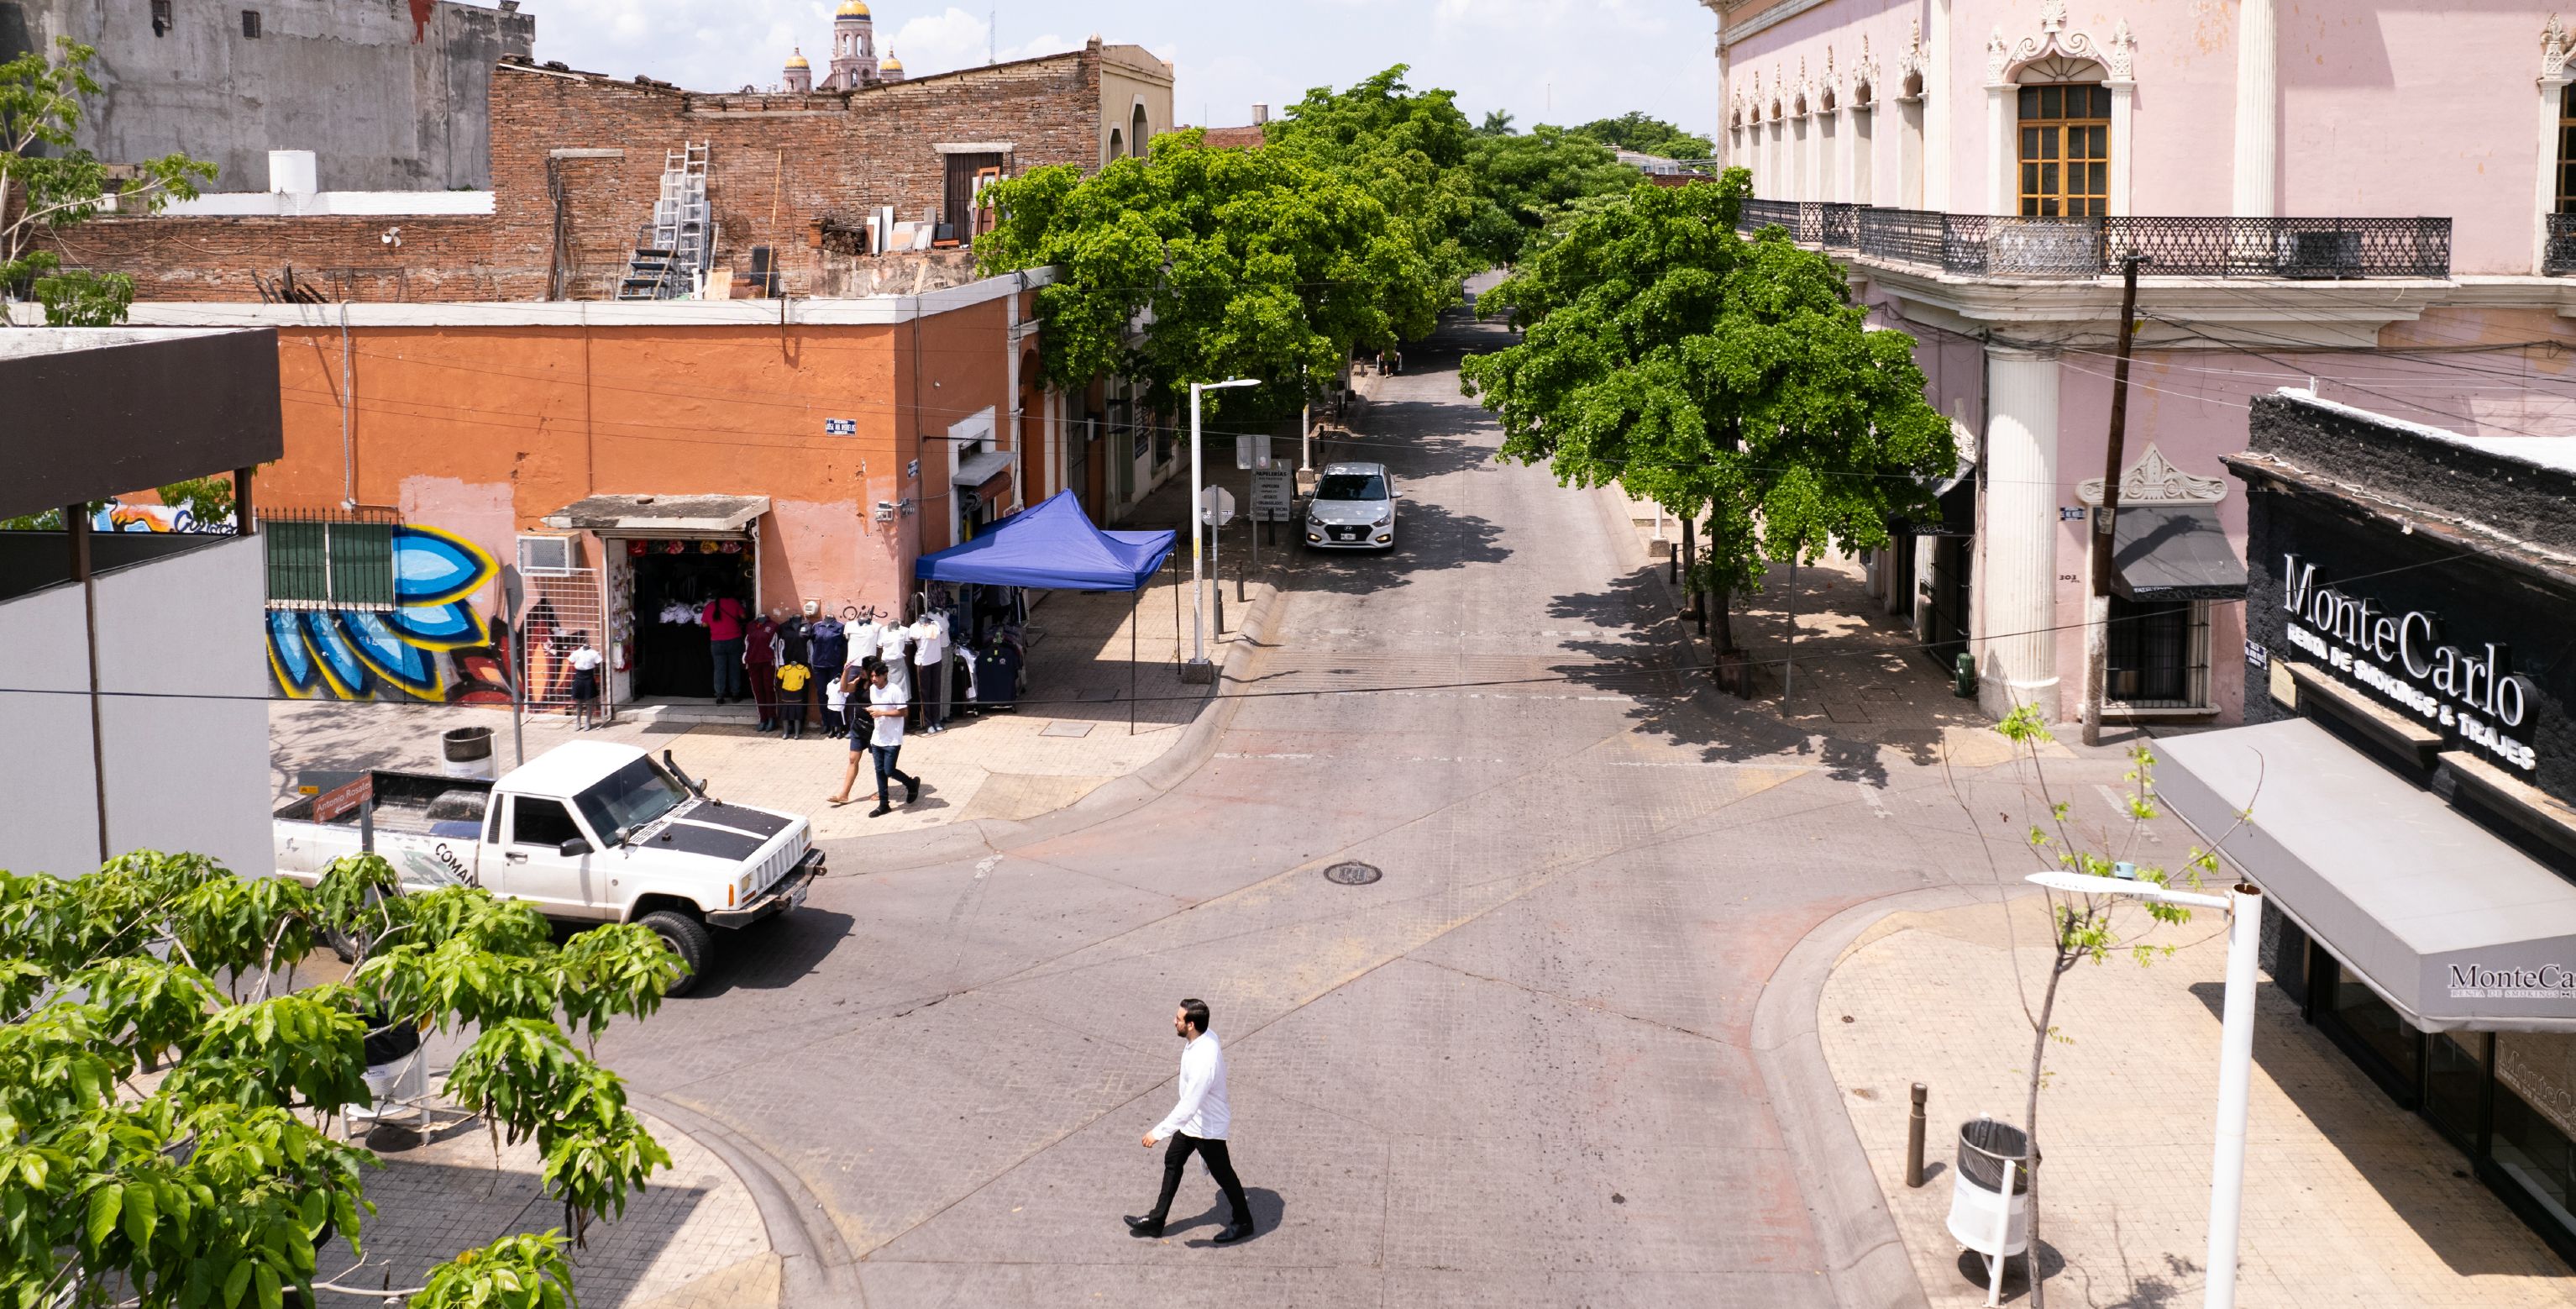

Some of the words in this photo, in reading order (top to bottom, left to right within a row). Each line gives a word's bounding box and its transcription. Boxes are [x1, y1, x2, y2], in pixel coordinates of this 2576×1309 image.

[2284, 553, 2525, 727] MonteCarlo
[2287, 623, 2328, 660] RENTA
[2330, 646, 2353, 673] DE
[2354, 660, 2437, 718] SMOKINGS
[2458, 712, 2537, 770] TRAJES
[317, 793, 345, 814] Antonio
[346, 781, 371, 798] Rosales
[436, 843, 483, 889] COMAN
[2451, 990, 2485, 998] RENTA
[2487, 990, 2502, 998] DE
